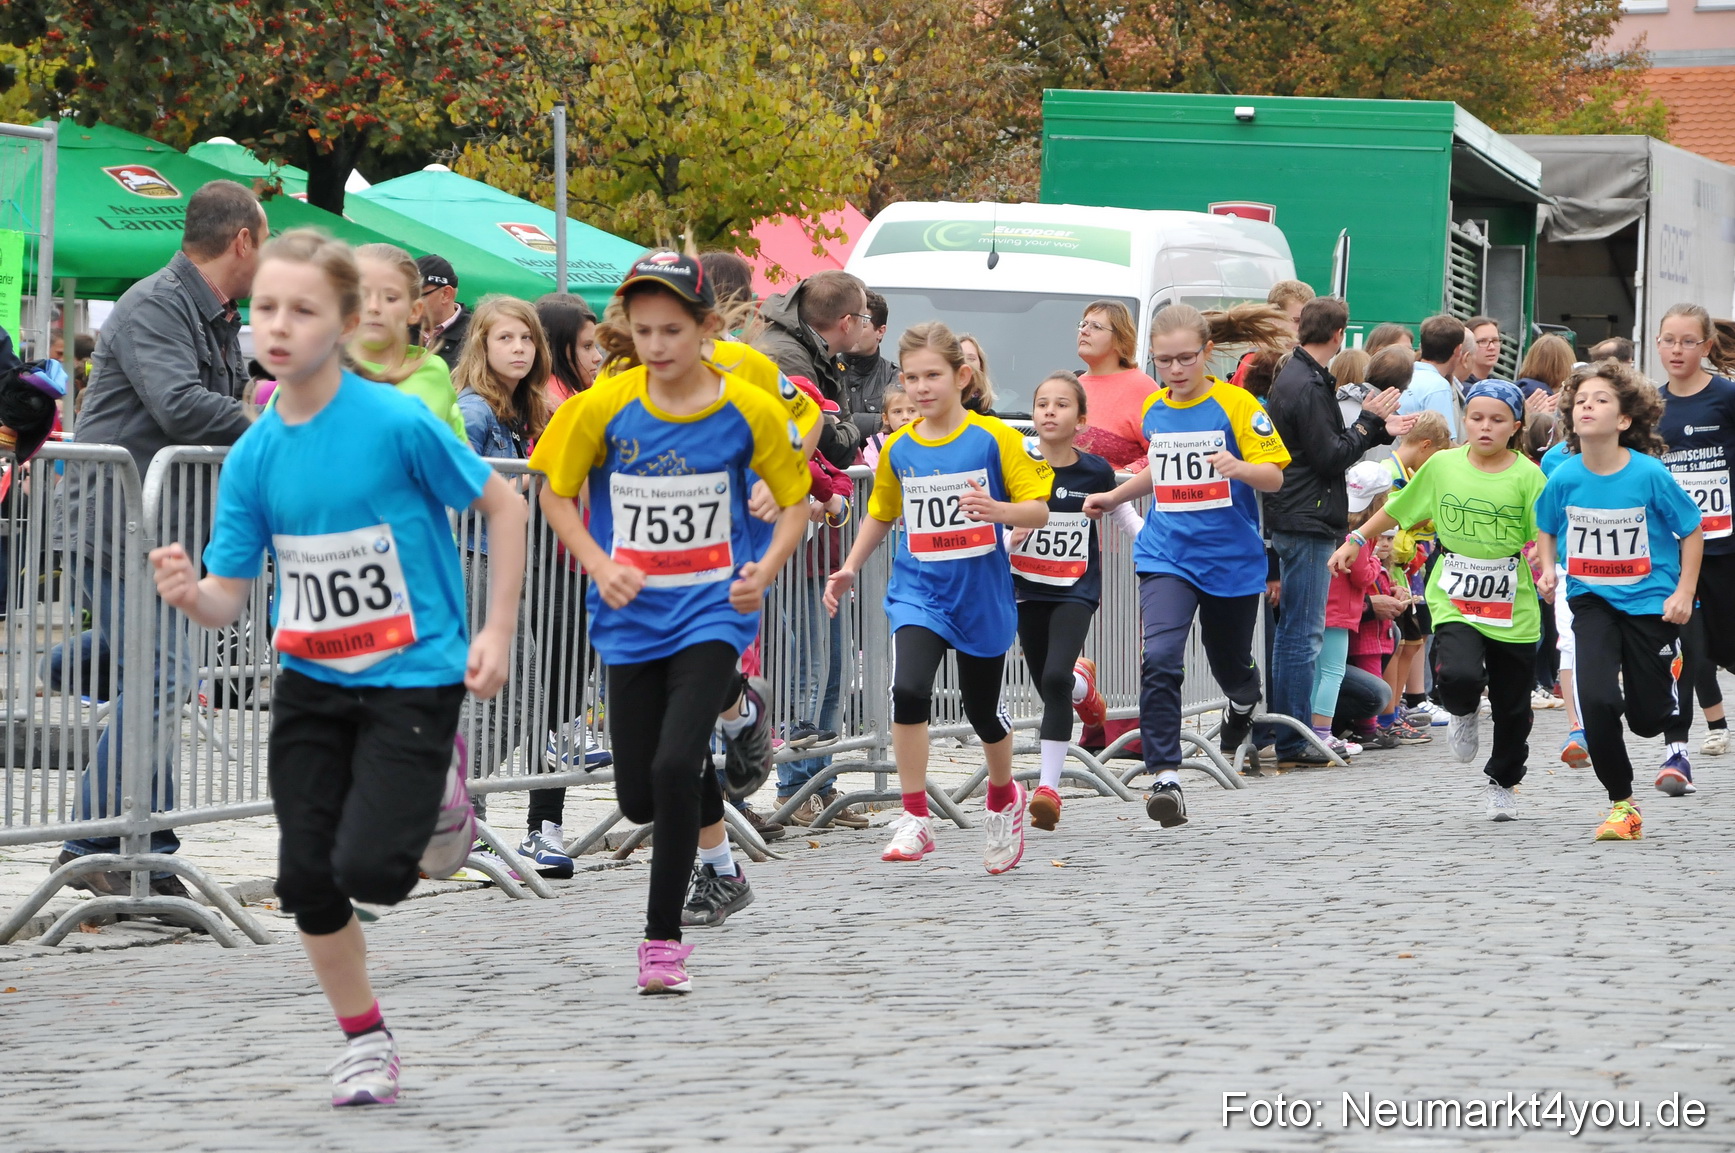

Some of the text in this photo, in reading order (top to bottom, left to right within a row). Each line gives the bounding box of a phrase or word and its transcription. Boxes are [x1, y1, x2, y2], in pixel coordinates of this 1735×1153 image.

[109, 205, 185, 215] Neum
[992, 225, 1074, 237] Europcar
[978, 237, 1080, 250] moving your way
[428, 275, 448, 284] FT-3
[1151, 440, 1211, 449] PARTL Neumarkt
[1155, 451, 1219, 481] 7167
[1682, 479, 1717, 487] Neumarkt
[613, 485, 710, 499] PARTL Neumarkt
[1172, 488, 1204, 501] Meike
[1686, 488, 1724, 513] 20
[910, 495, 982, 529] 702
[622, 501, 720, 545] 7537
[1046, 517, 1078, 528] eumarkt
[1569, 513, 1632, 525] PARTL Neumarkt
[932, 535, 967, 549] Maria
[1573, 526, 1640, 556] 7117
[278, 545, 368, 563] PARTL Neumarkt
[1445, 560, 1506, 571] PARTL Neumarkt
[1582, 562, 1634, 575] Franziska
[1448, 572, 1509, 599] 7004
[287, 564, 393, 622] 7063
[1465, 603, 1481, 614] Eva
[304, 631, 375, 655] Tamina
